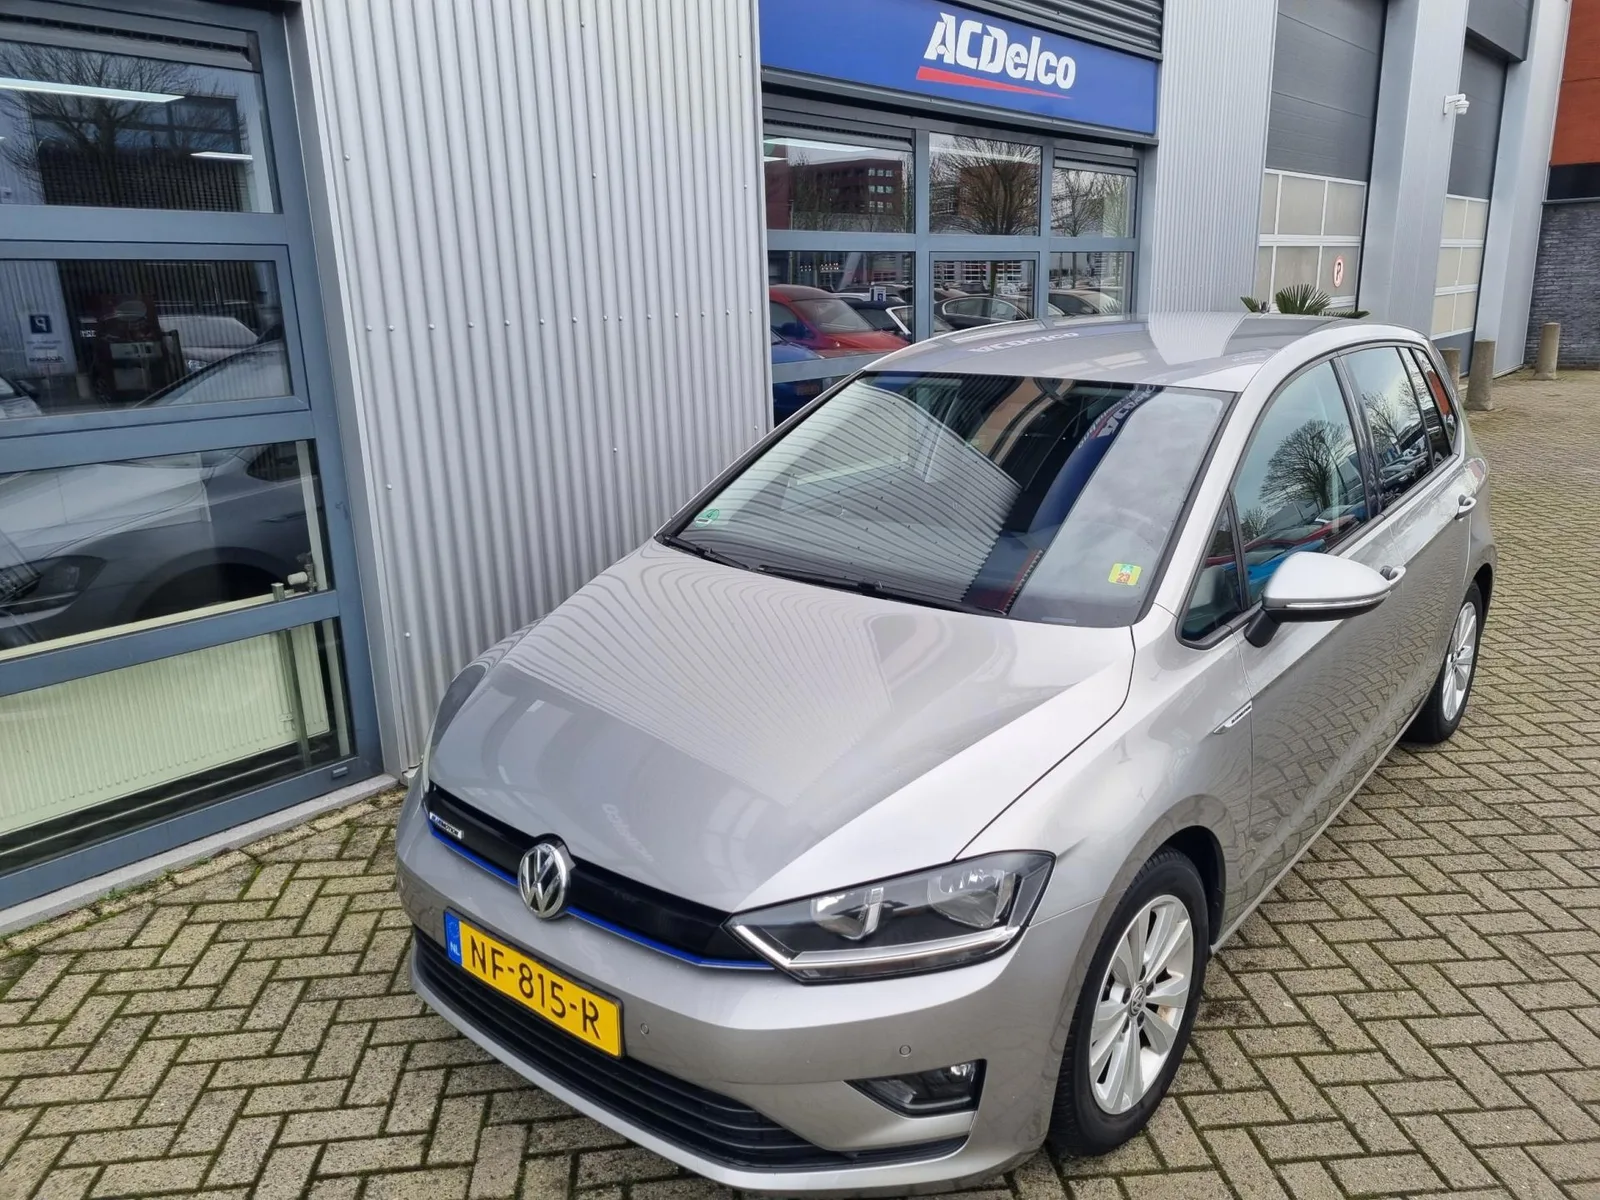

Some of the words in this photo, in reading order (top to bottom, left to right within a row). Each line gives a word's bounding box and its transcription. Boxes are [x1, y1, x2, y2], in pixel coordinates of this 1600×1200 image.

[923, 12, 1077, 90] ACDelco
[449, 941, 461, 957] NL
[470, 935, 602, 1040] NF-815-R
